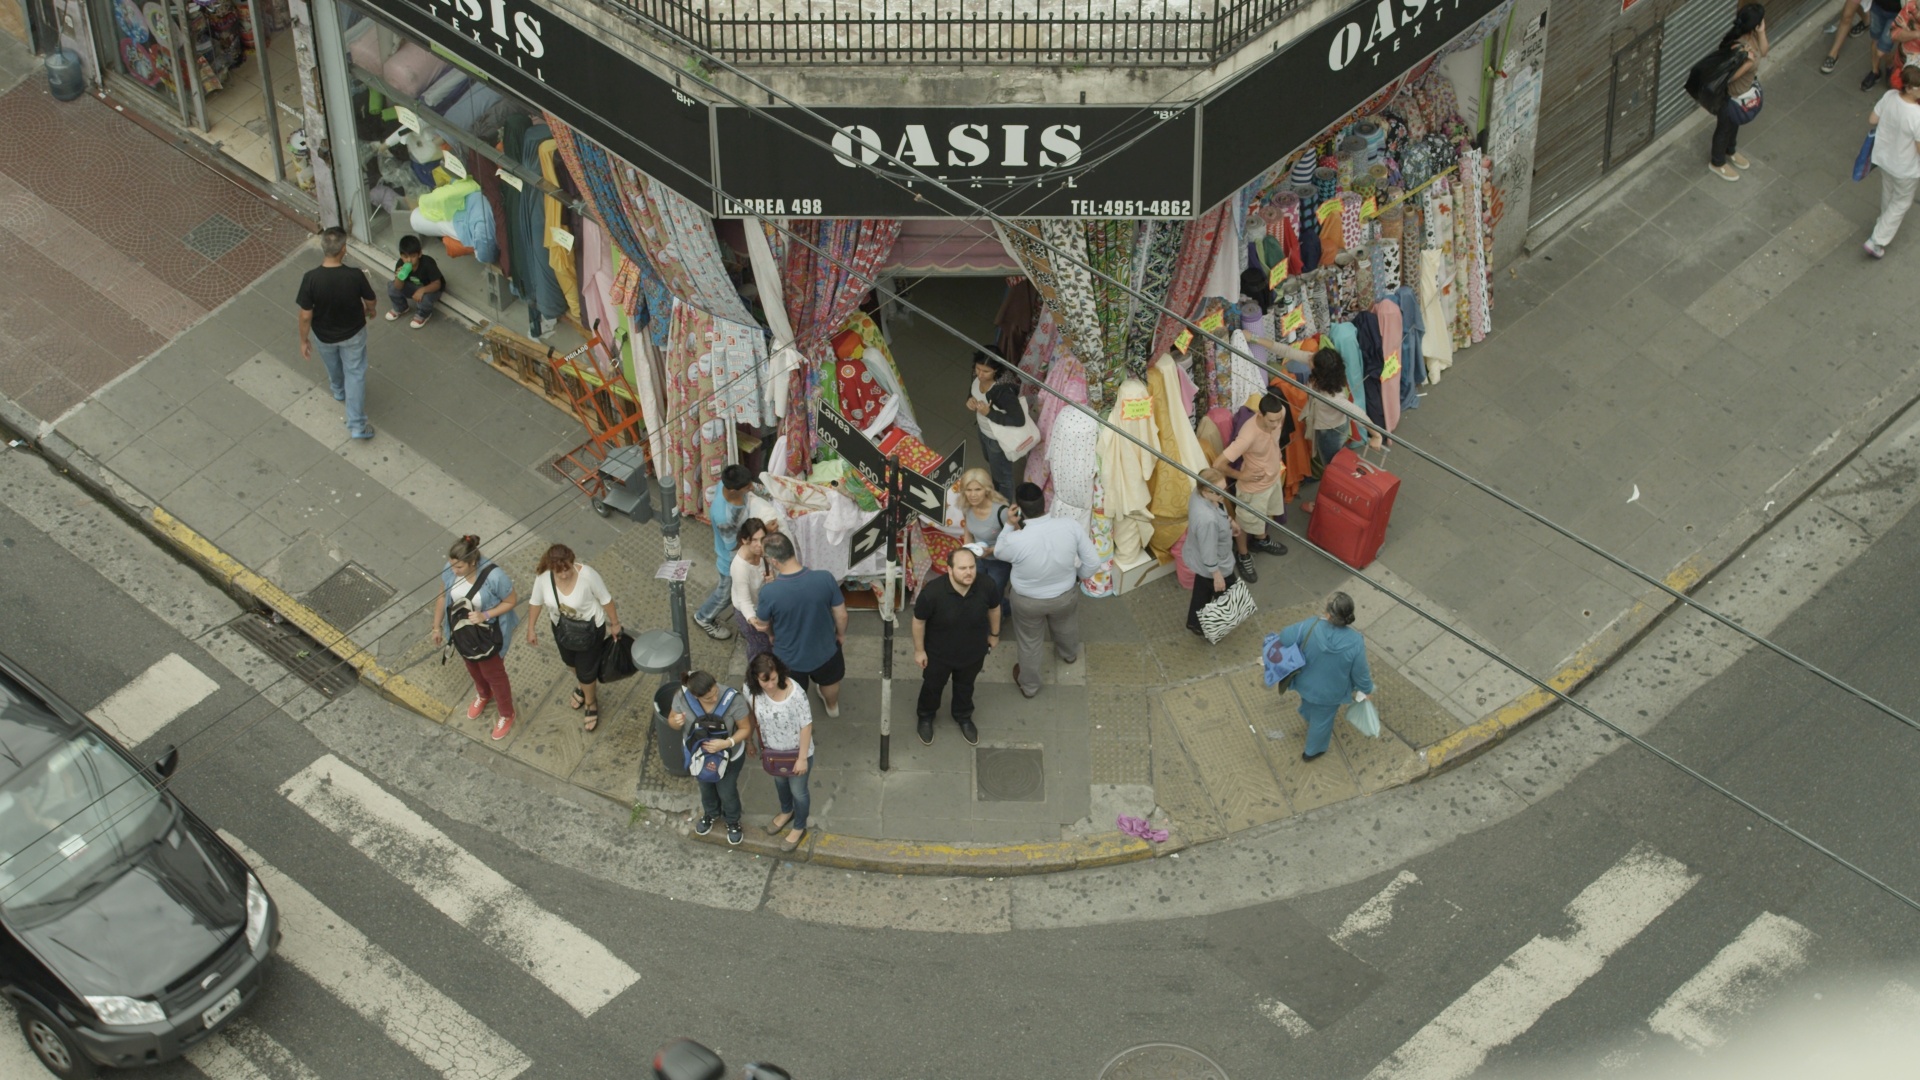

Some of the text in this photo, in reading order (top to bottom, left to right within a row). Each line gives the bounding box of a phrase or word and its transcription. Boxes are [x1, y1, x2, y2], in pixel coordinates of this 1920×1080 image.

[1328, 0, 1441, 71] OAS
[831, 124, 1082, 168] OASIS
[725, 199, 822, 214] LARREA 498
[1071, 200, 1191, 215] TEL:4951-4862
[819, 400, 850, 435] Larrea
[817, 427, 839, 449] 400
[858, 461, 879, 485] 500
